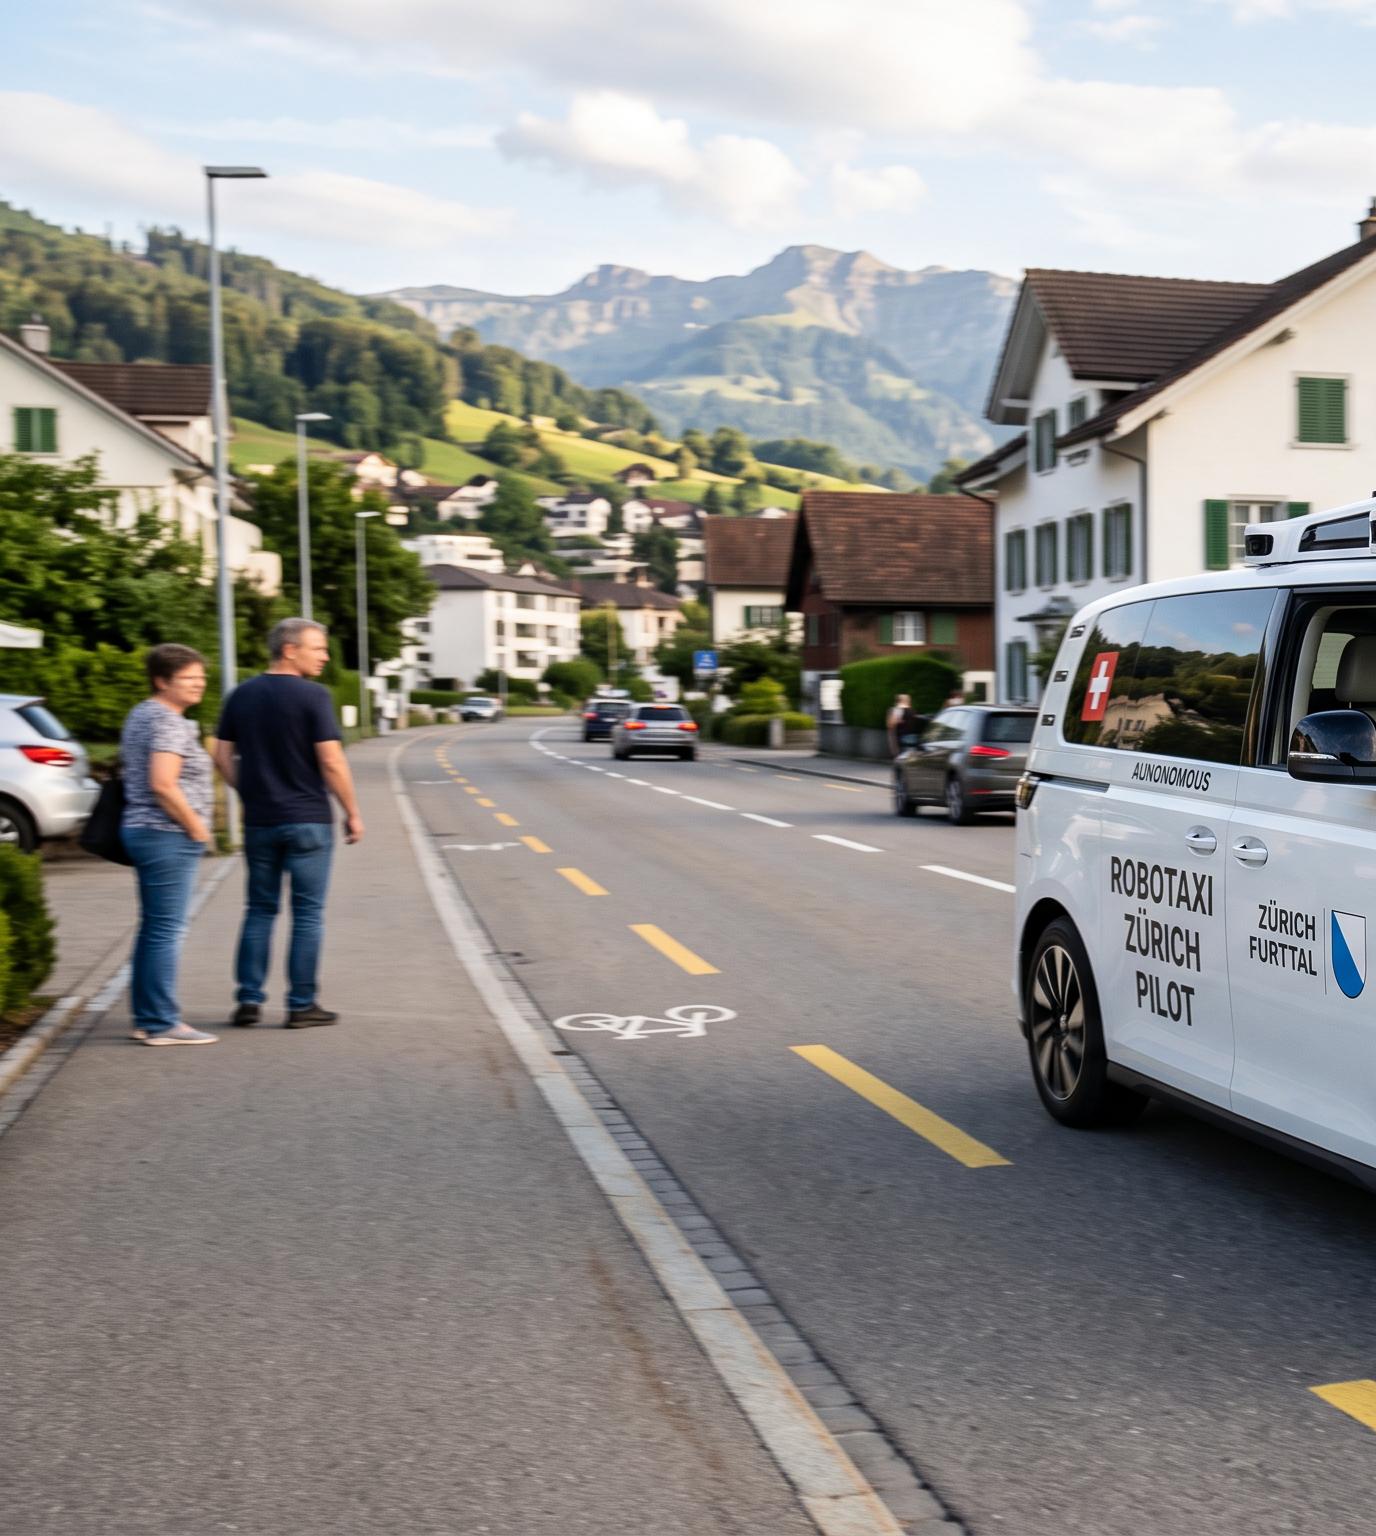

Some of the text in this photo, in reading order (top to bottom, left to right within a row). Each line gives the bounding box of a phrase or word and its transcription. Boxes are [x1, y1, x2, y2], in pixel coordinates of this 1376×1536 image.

[1131, 762, 1211, 792] AUNONOMOUS
[1111, 855, 1213, 917] ROBOTAXI
[1124, 907, 1201, 973] ZÜRICH
[1258, 899, 1316, 942] ZÜRICH
[1249, 935, 1318, 977] FURTTAL
[1136, 970, 1195, 1027] PILOT
